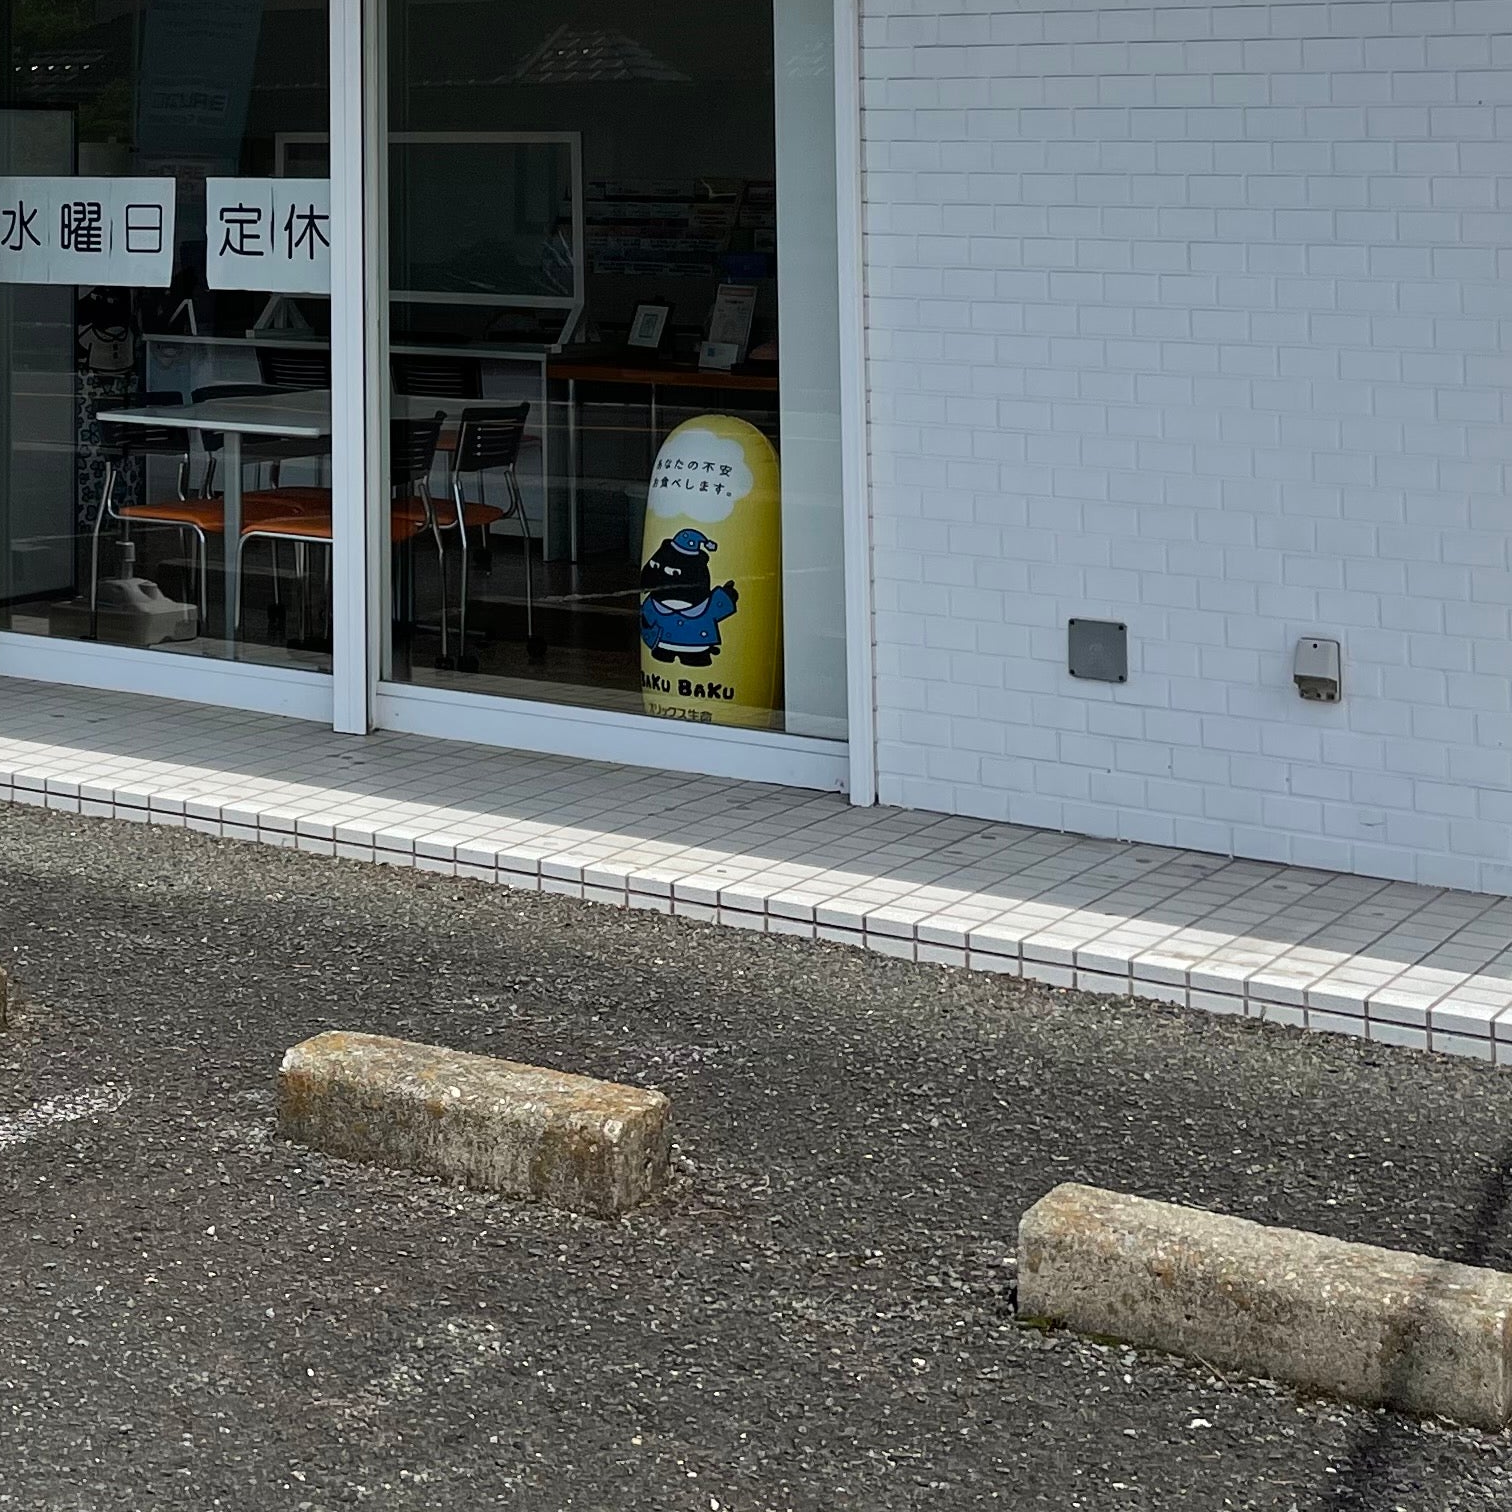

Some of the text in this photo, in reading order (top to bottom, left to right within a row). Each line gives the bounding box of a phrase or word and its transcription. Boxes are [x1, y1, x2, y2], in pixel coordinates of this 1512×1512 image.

[1, 200, 163, 254] 水曜日
[657, 458, 733, 478] あなたの不安
[678, 678, 735, 700] BAKU
